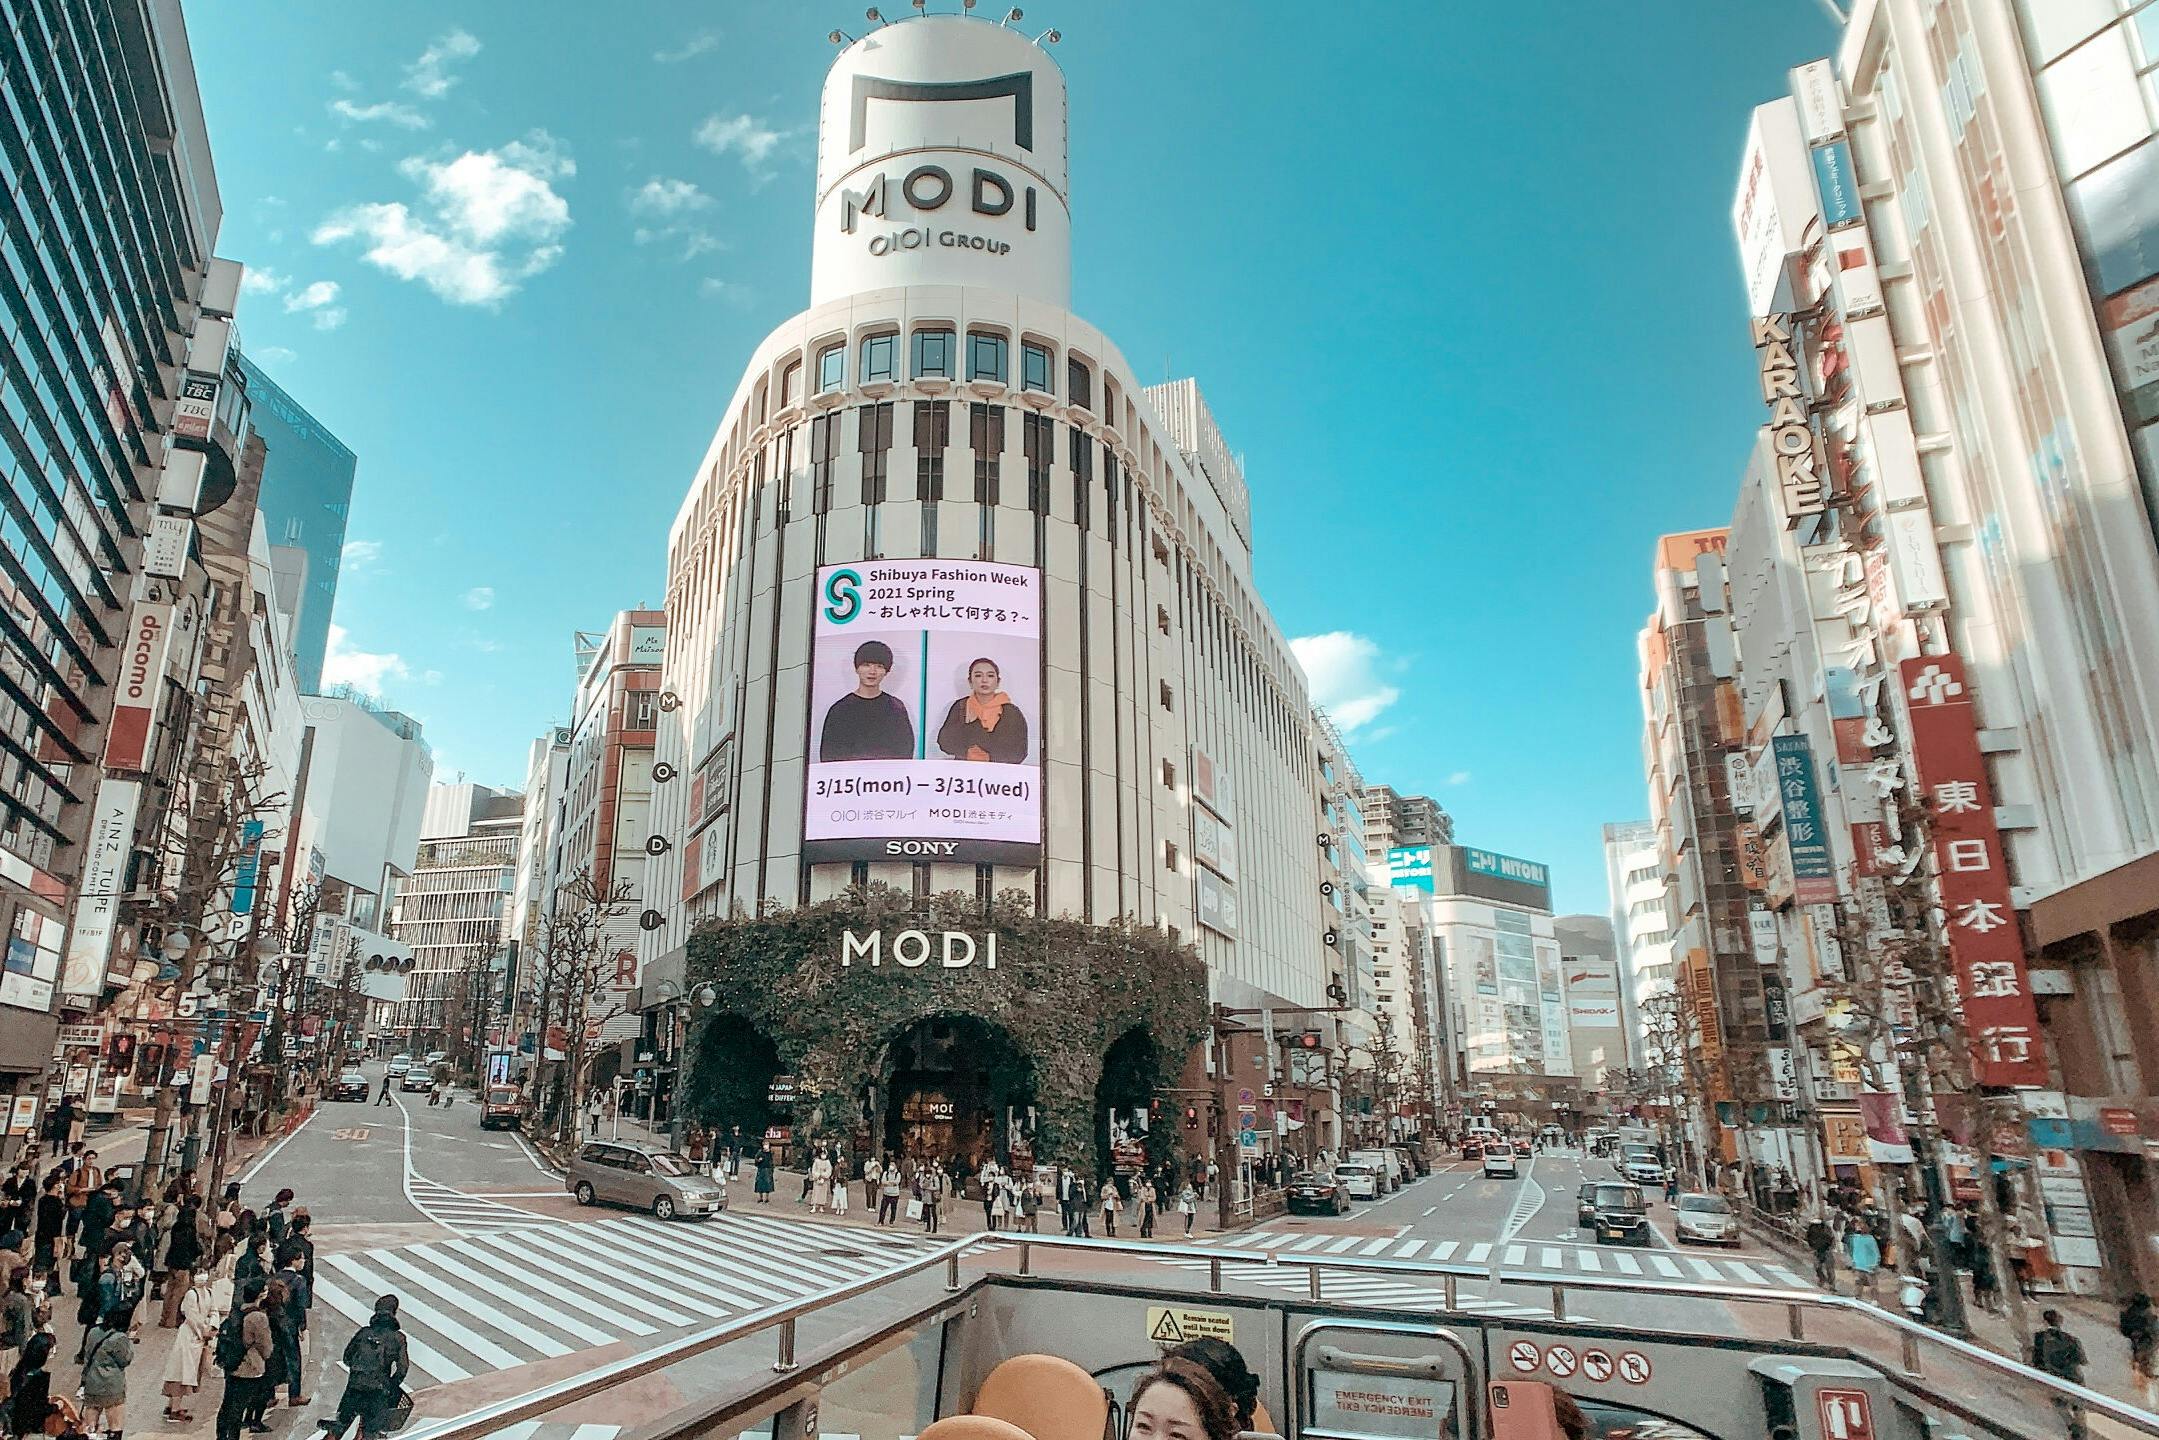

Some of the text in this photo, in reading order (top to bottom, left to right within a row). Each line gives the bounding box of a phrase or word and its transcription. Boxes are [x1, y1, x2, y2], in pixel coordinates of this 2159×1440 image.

[841, 165, 1036, 234] MODI
[939, 230, 1011, 255] GROUP
[186, 387, 213, 399] TBC
[182, 404, 209, 416] TBC
[1752, 312, 1825, 518] KARAOKE
[870, 569, 1028, 587] Shibuya Fashion Week
[869, 587, 955, 601] 2021 Spring
[128, 615, 161, 698] docomo
[816, 776, 911, 797] 3/15(mon)
[934, 777, 1029, 800] 3/31(wed)
[1779, 756, 1815, 841] 渋谷整形
[863, 809, 918, 821] 渋谷マルイ
[929, 808, 1013, 821] MODI 渋谷モディ
[885, 840, 959, 856] SONY
[95, 808, 124, 914] AINZ TULPE
[1391, 849, 1431, 867] ニトリ
[1471, 851, 1545, 882] ニトリ NITORI
[232, 921, 244, 934] P
[1934, 781, 2033, 1063] 東日本銀行
[842, 929, 997, 969] MODI
[615, 952, 637, 985] R
[178, 991, 197, 1017] 5
[285, 1036, 296, 1048] P
[1264, 1083, 1273, 1096] 5
[1183, 1314, 1206, 1322] Remain
[1335, 1391, 1431, 1406] EMERGENCY EXIT
